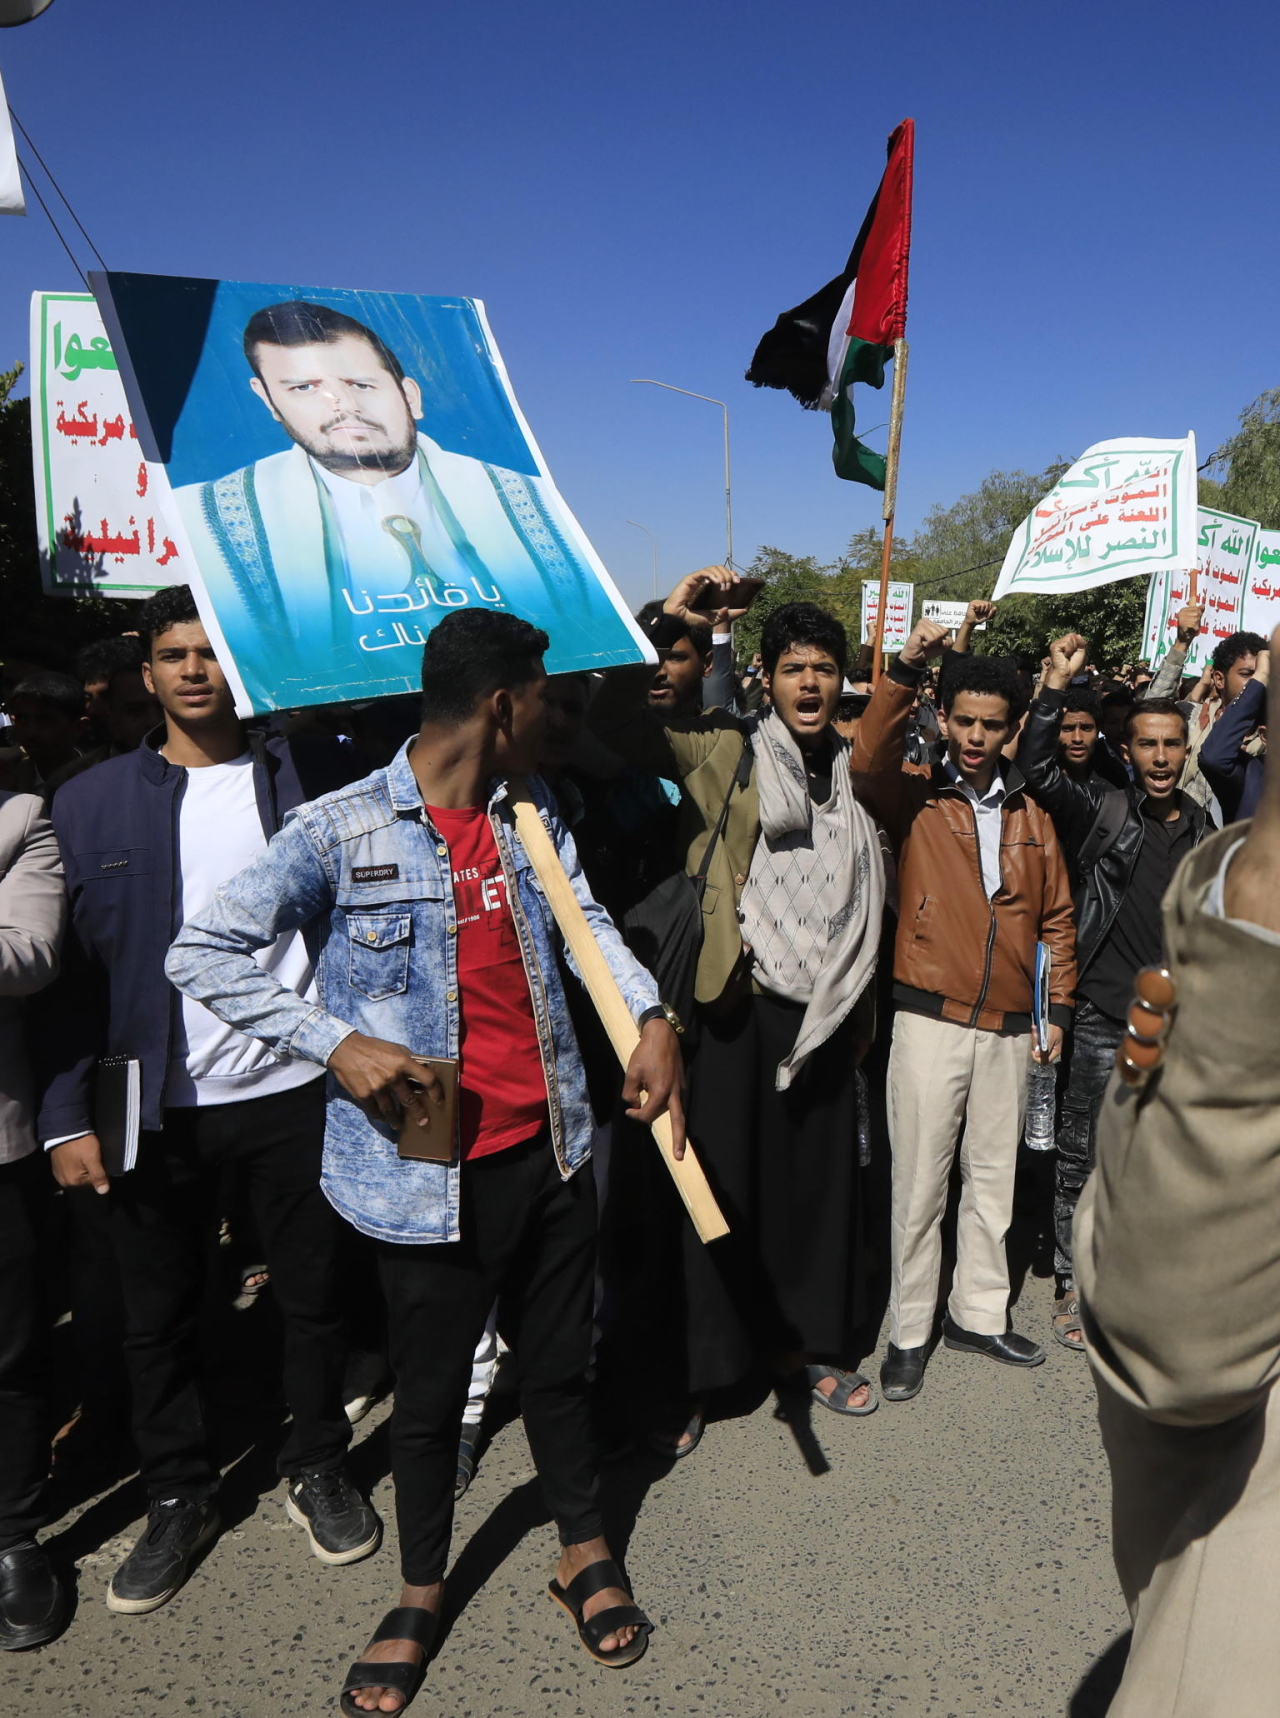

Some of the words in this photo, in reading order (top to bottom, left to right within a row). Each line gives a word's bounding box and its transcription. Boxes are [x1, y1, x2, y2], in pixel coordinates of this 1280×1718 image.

[53, 319, 119, 382] عوا
[136, 461, 148, 498] و
[1051, 456, 1122, 498] أكب
[1104, 483, 1168, 506] الموت
[1078, 513, 1110, 532] على
[1117, 505, 1168, 523] اللعنة
[1096, 526, 1168, 561] النصر
[1220, 528, 1251, 557] الله
[1212, 564, 1245, 586] الموت
[341, 577, 470, 616] قائدنا
[469, 576, 506, 608] يا
[1208, 595, 1240, 614] الموت
[355, 867, 394, 879] SUPERDRY
[452, 867, 480, 884] ATES
